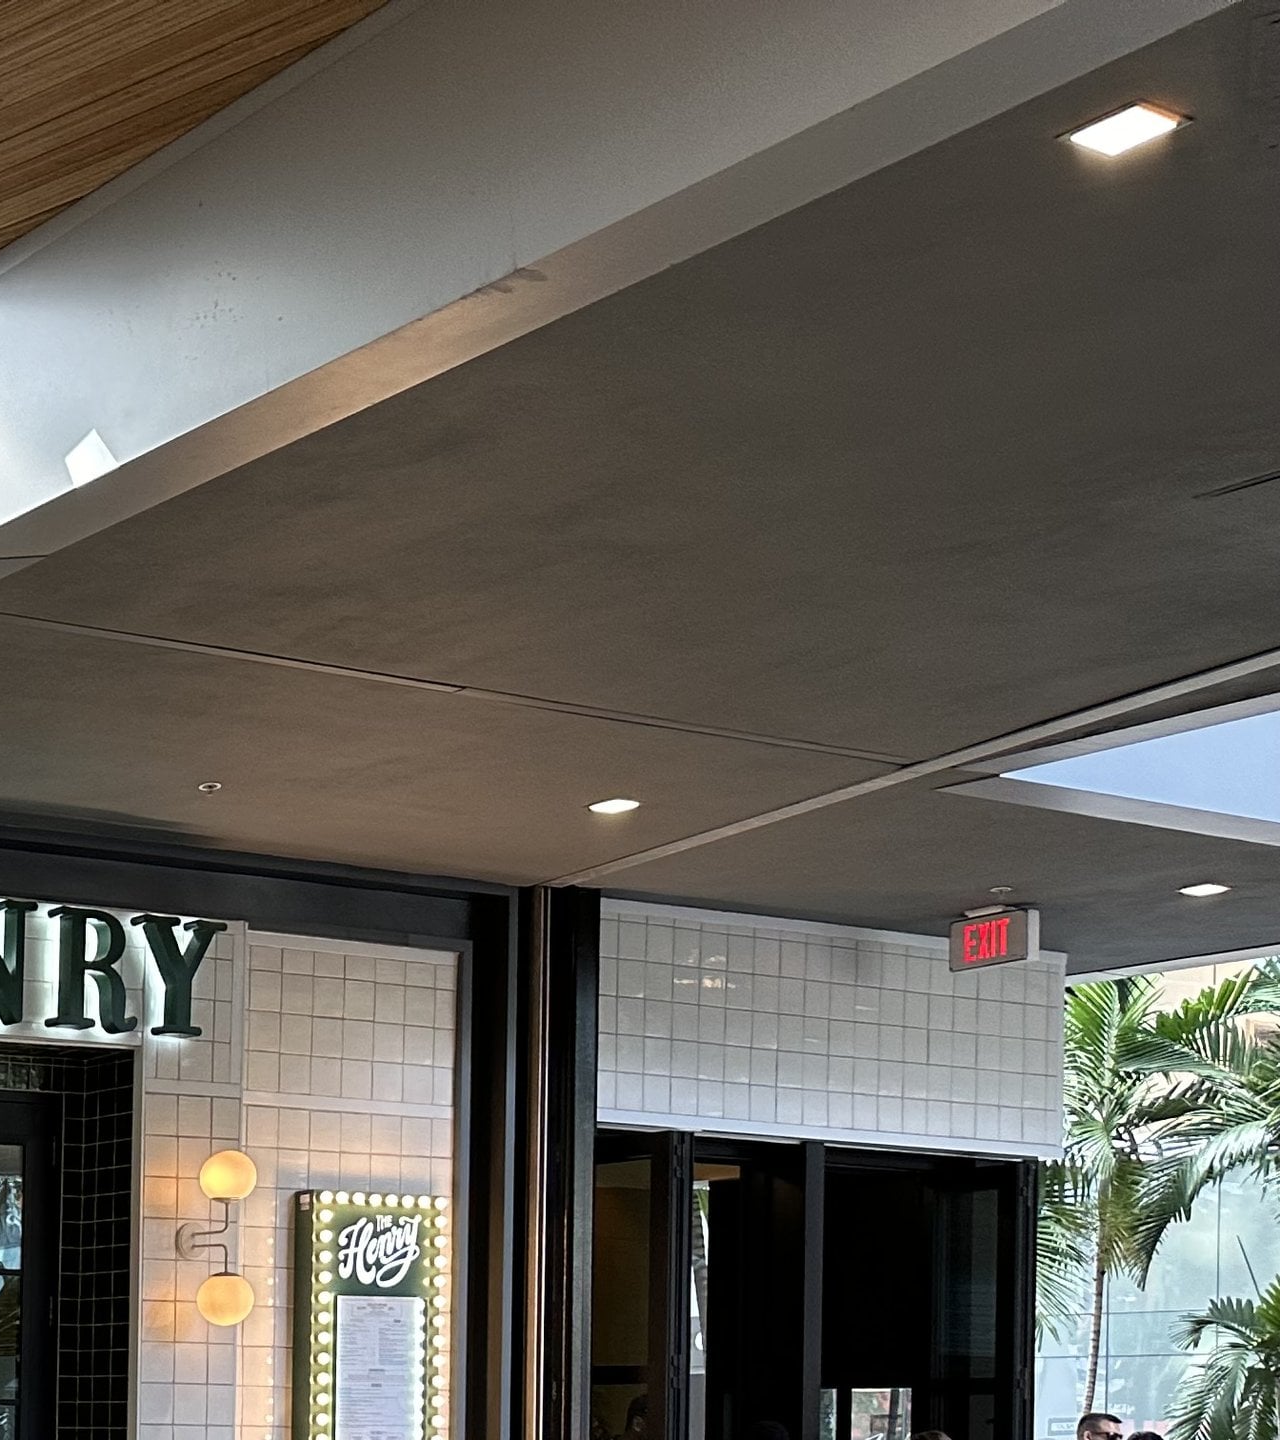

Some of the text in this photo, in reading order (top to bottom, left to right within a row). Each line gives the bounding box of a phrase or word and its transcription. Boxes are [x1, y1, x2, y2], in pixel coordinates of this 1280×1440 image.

[963, 917, 1011, 963] EXIT
[375, 1214, 393, 1232] THE
[337, 1213, 423, 1288] Henry
